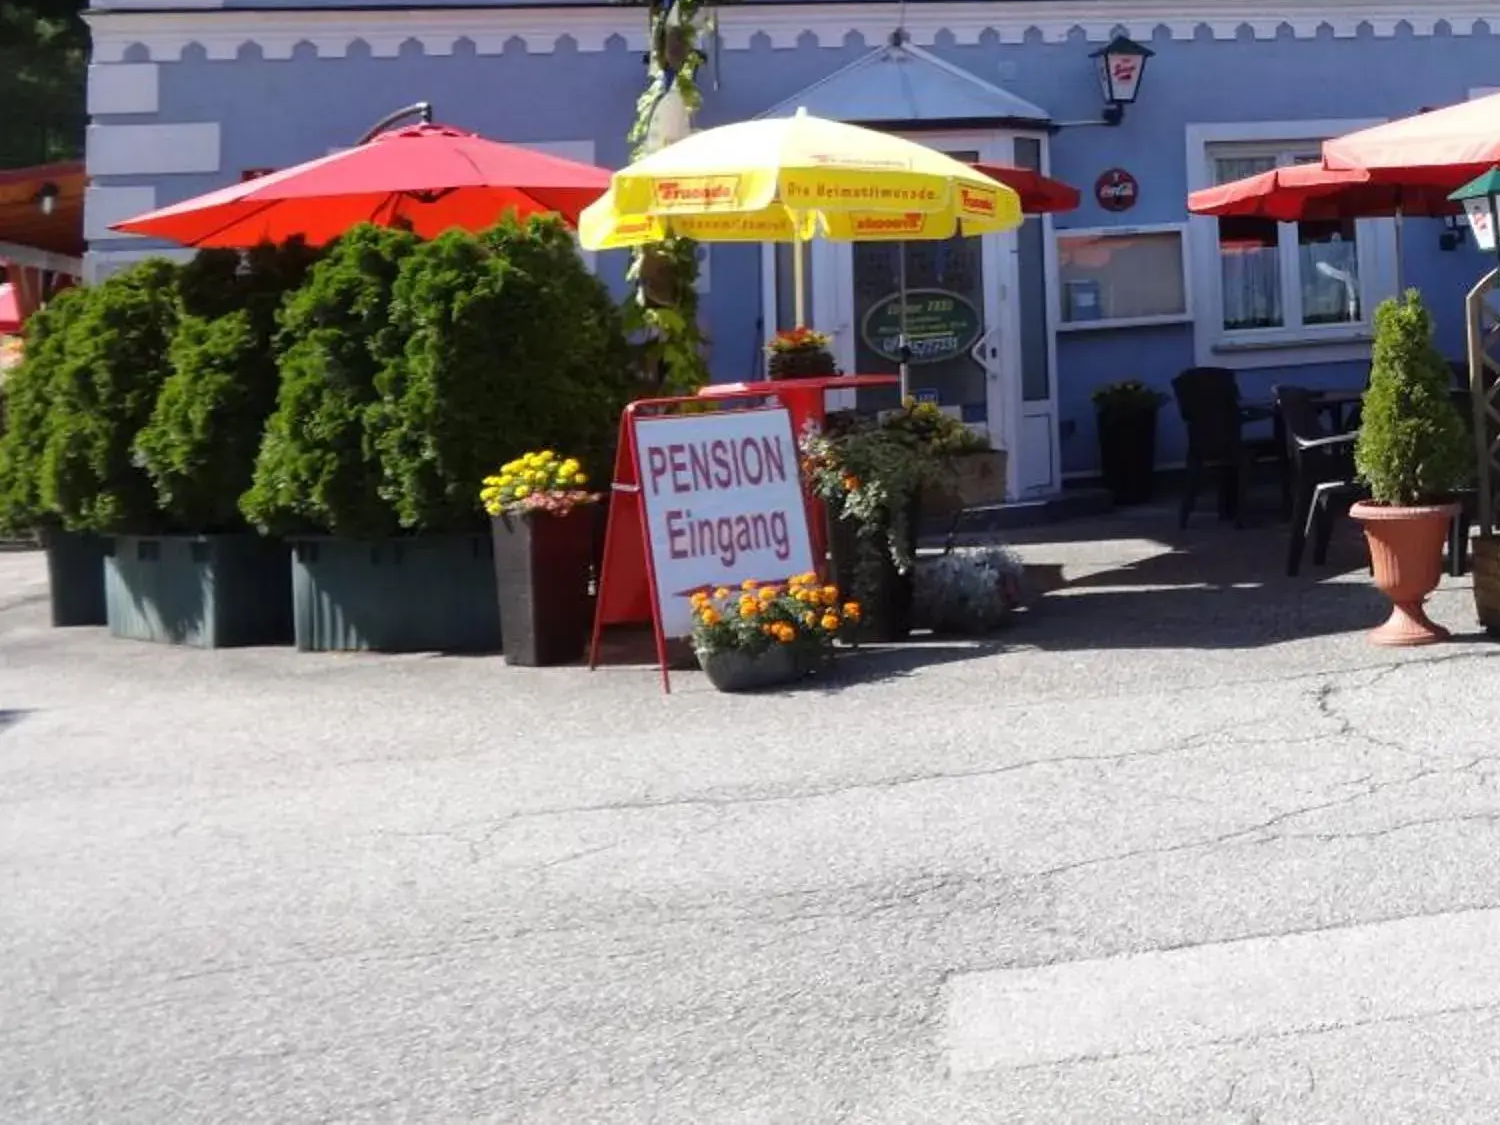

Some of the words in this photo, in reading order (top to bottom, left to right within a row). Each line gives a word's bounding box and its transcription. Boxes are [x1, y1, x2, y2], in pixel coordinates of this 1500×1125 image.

[787, 181, 811, 197] Die
[647, 435, 787, 496] PENSION
[665, 508, 791, 567] Eingang
